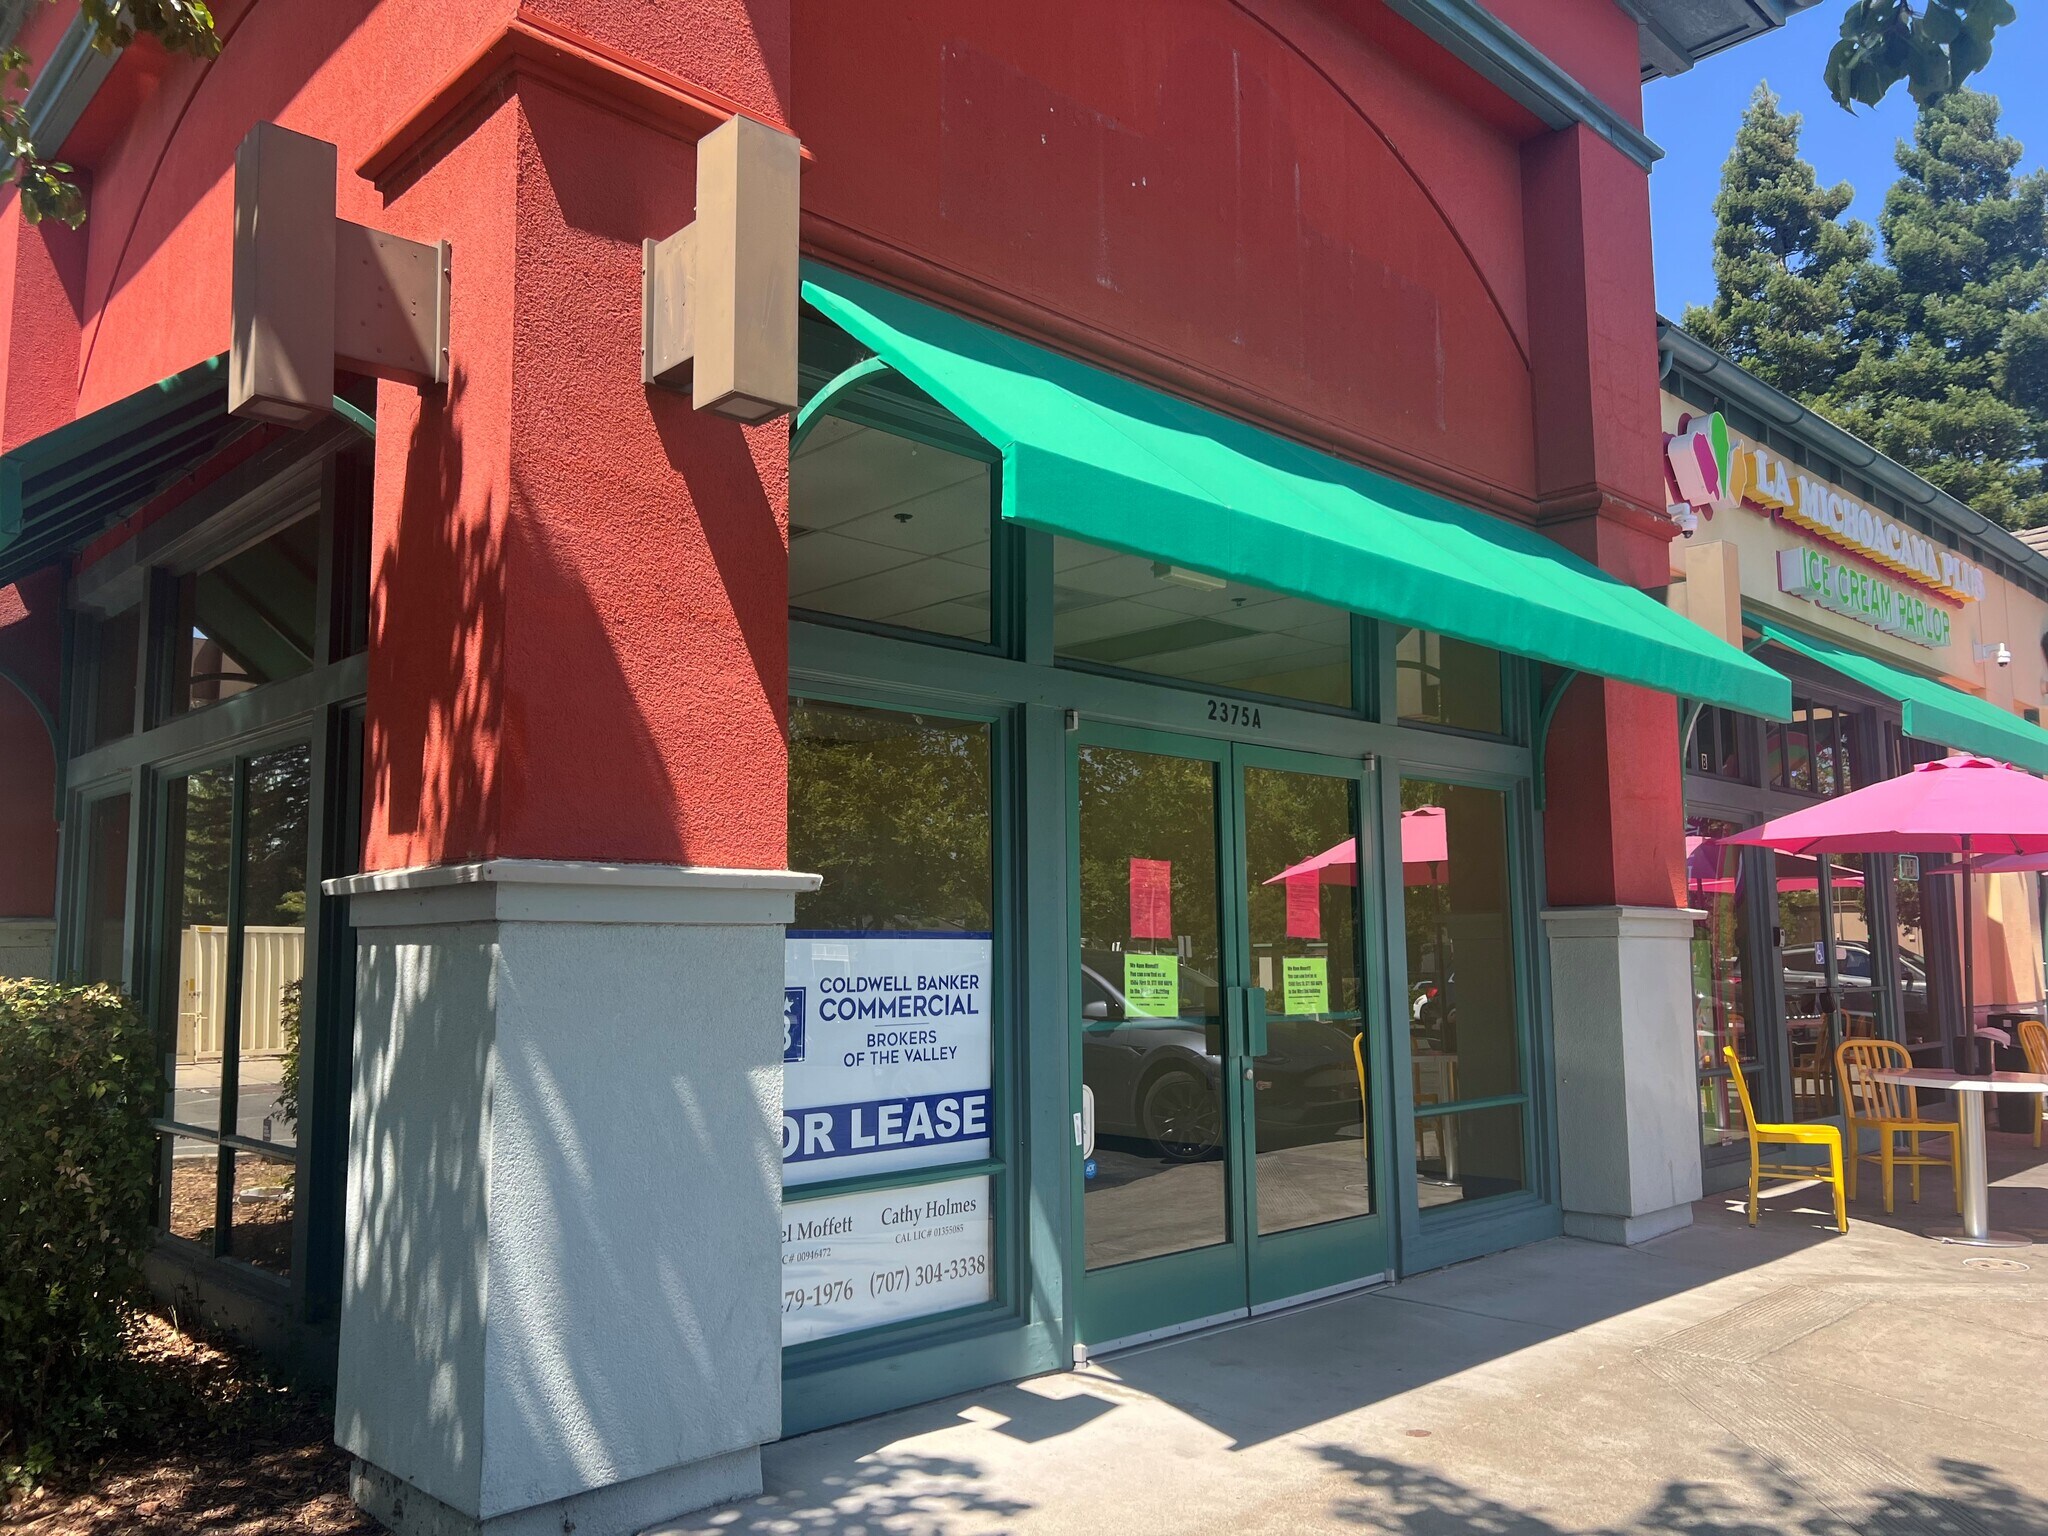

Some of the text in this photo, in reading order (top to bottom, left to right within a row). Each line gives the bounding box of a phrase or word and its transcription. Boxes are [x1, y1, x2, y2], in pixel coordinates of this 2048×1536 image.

[1753, 449, 1986, 602] LA MICHOACANA PLUS
[1801, 546, 1951, 646] ICE CREAM PARLOR
[1207, 699, 1262, 729] 2375A
[819, 974, 980, 994] COLDWELL BANKER
[818, 993, 980, 1022] COMMERCIAL
[866, 1029, 938, 1048] BROKERS
[843, 1046, 958, 1068] OF THE VALLEY
[850, 1095, 987, 1150] LEASE
[881, 1198, 977, 1226] Cathy Holmes
[797, 1216, 853, 1241] Moffett
[895, 1232, 912, 1244] CAL
[913, 1229, 932, 1241] LIC#
[869, 1254, 985, 1299] (707) 304-3338
[781, 1279, 854, 1313] 79-1976
